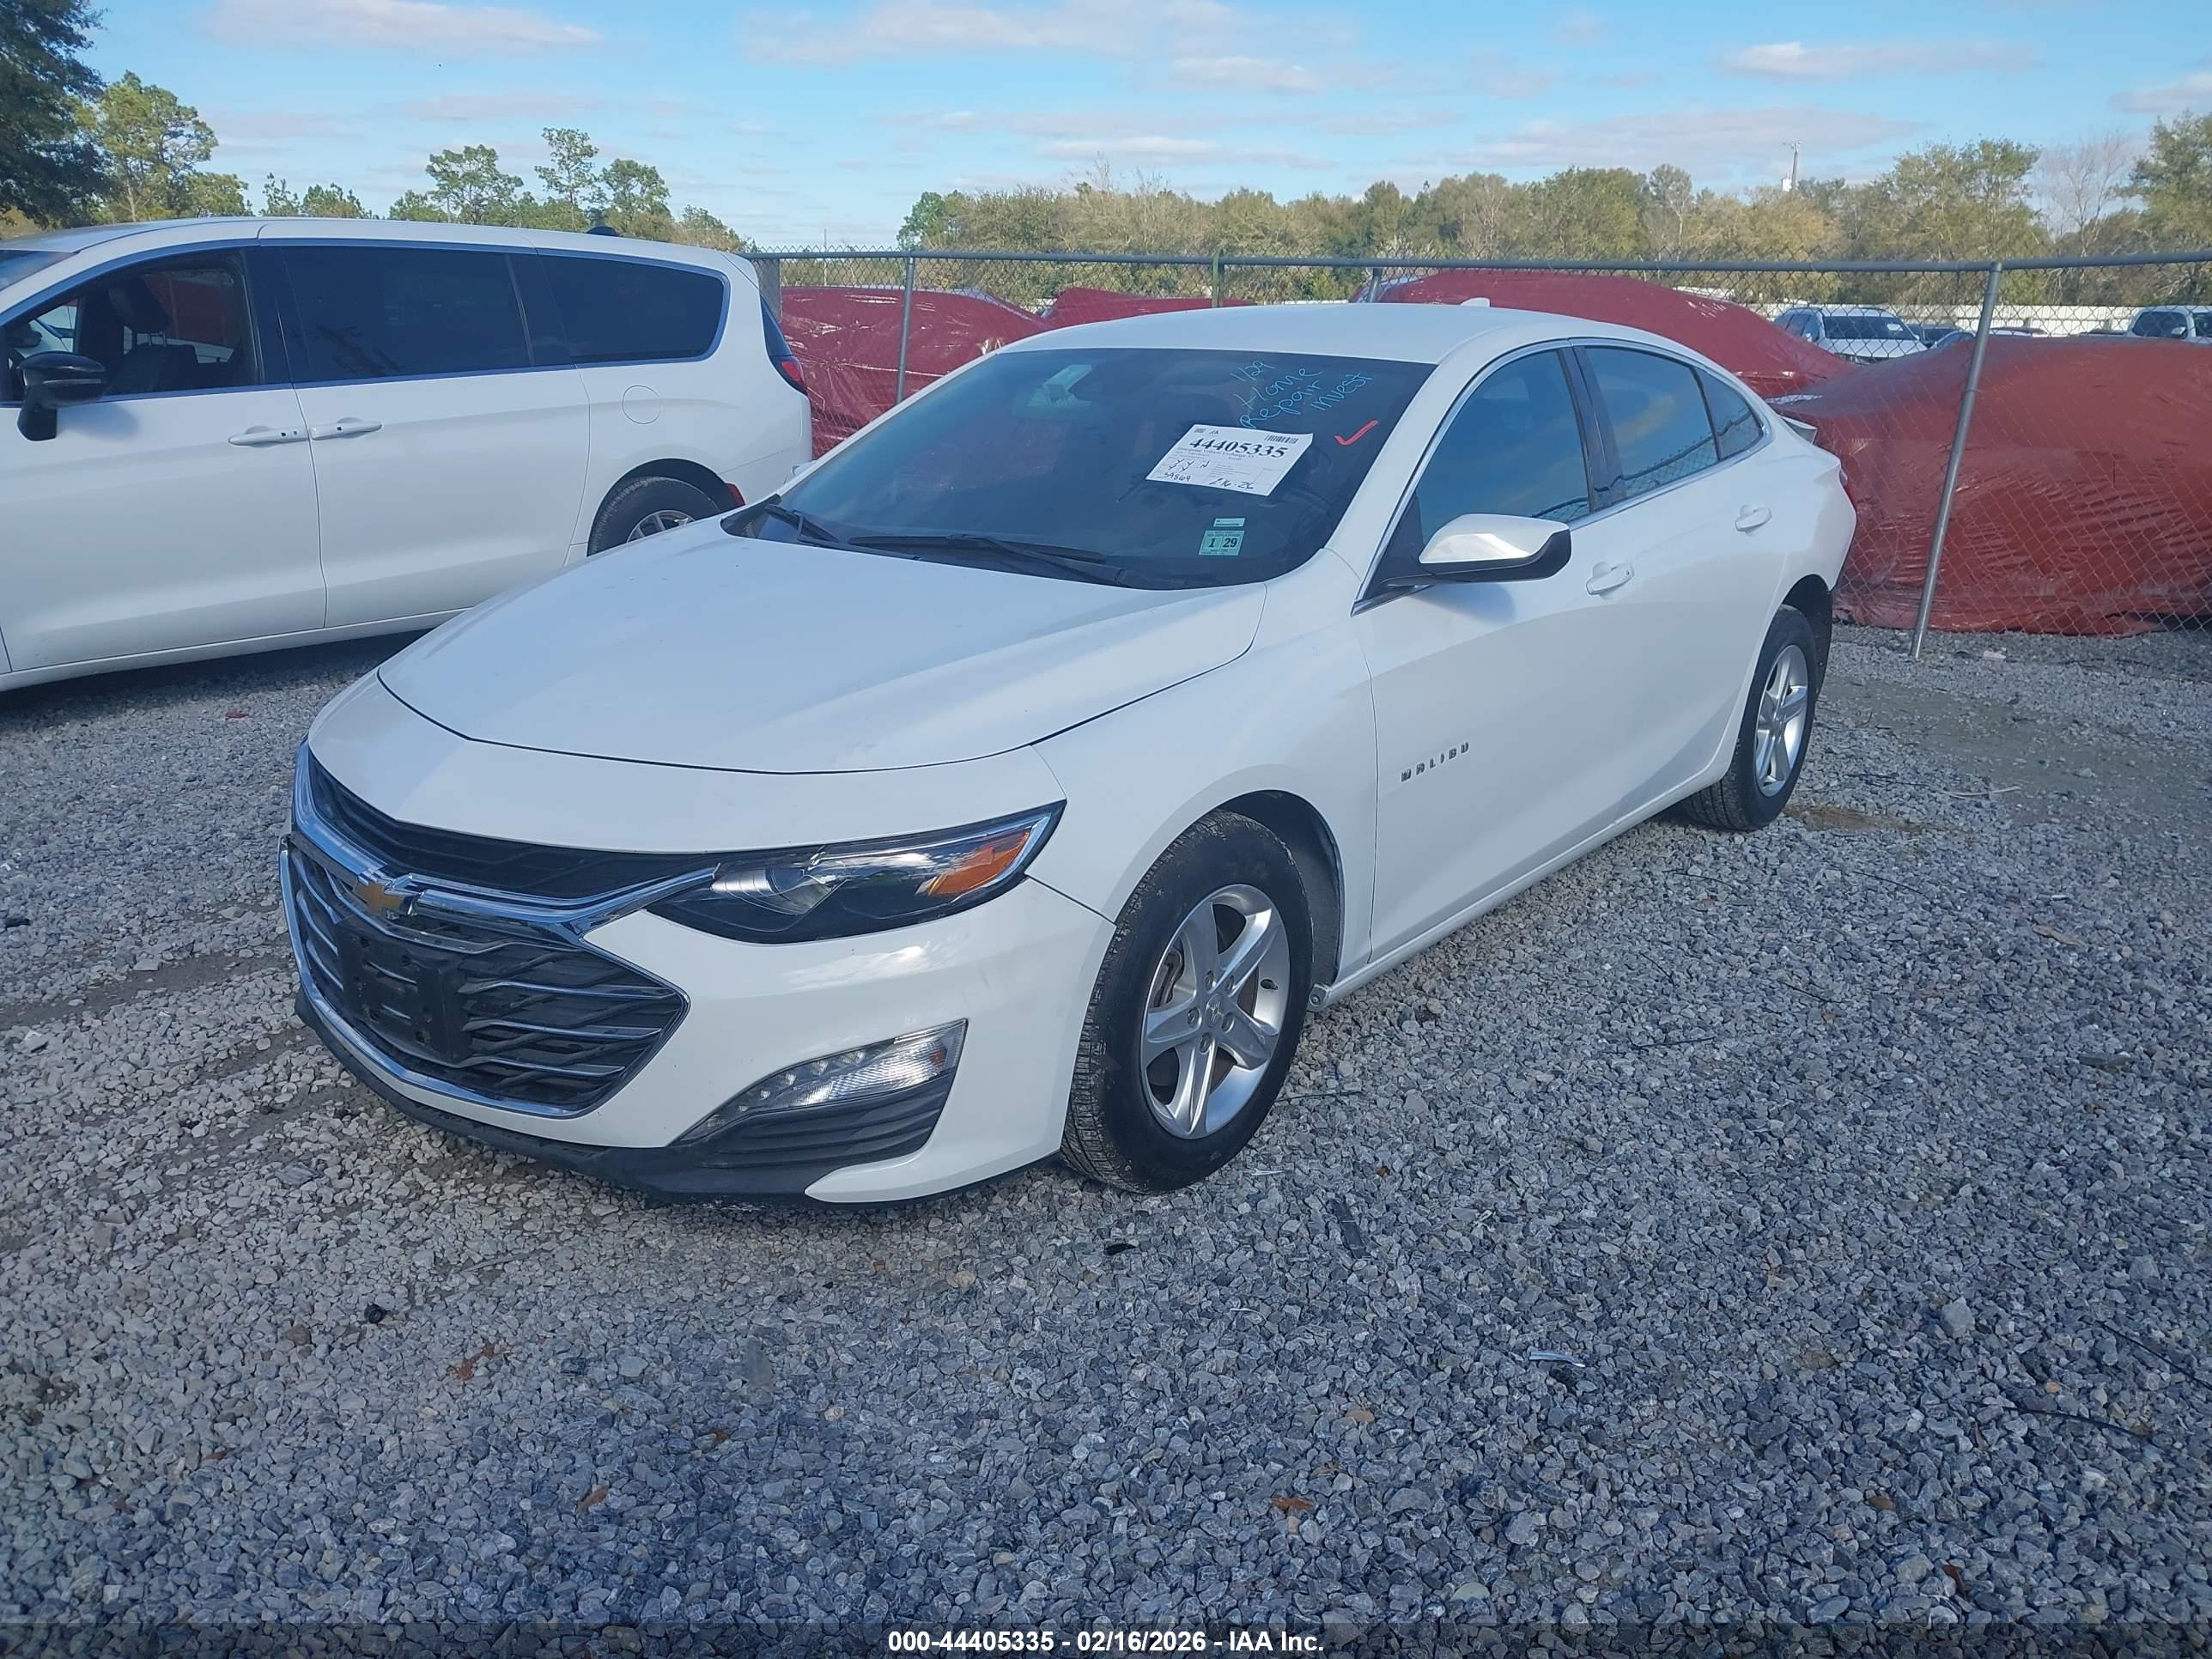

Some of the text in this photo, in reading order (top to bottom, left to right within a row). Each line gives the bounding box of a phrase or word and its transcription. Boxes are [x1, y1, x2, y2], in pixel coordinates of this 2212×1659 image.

[1189, 437, 1288, 459] 44405335
[1208, 538, 1238, 548] 1 29
[1401, 741, 1469, 782] MALIBU
